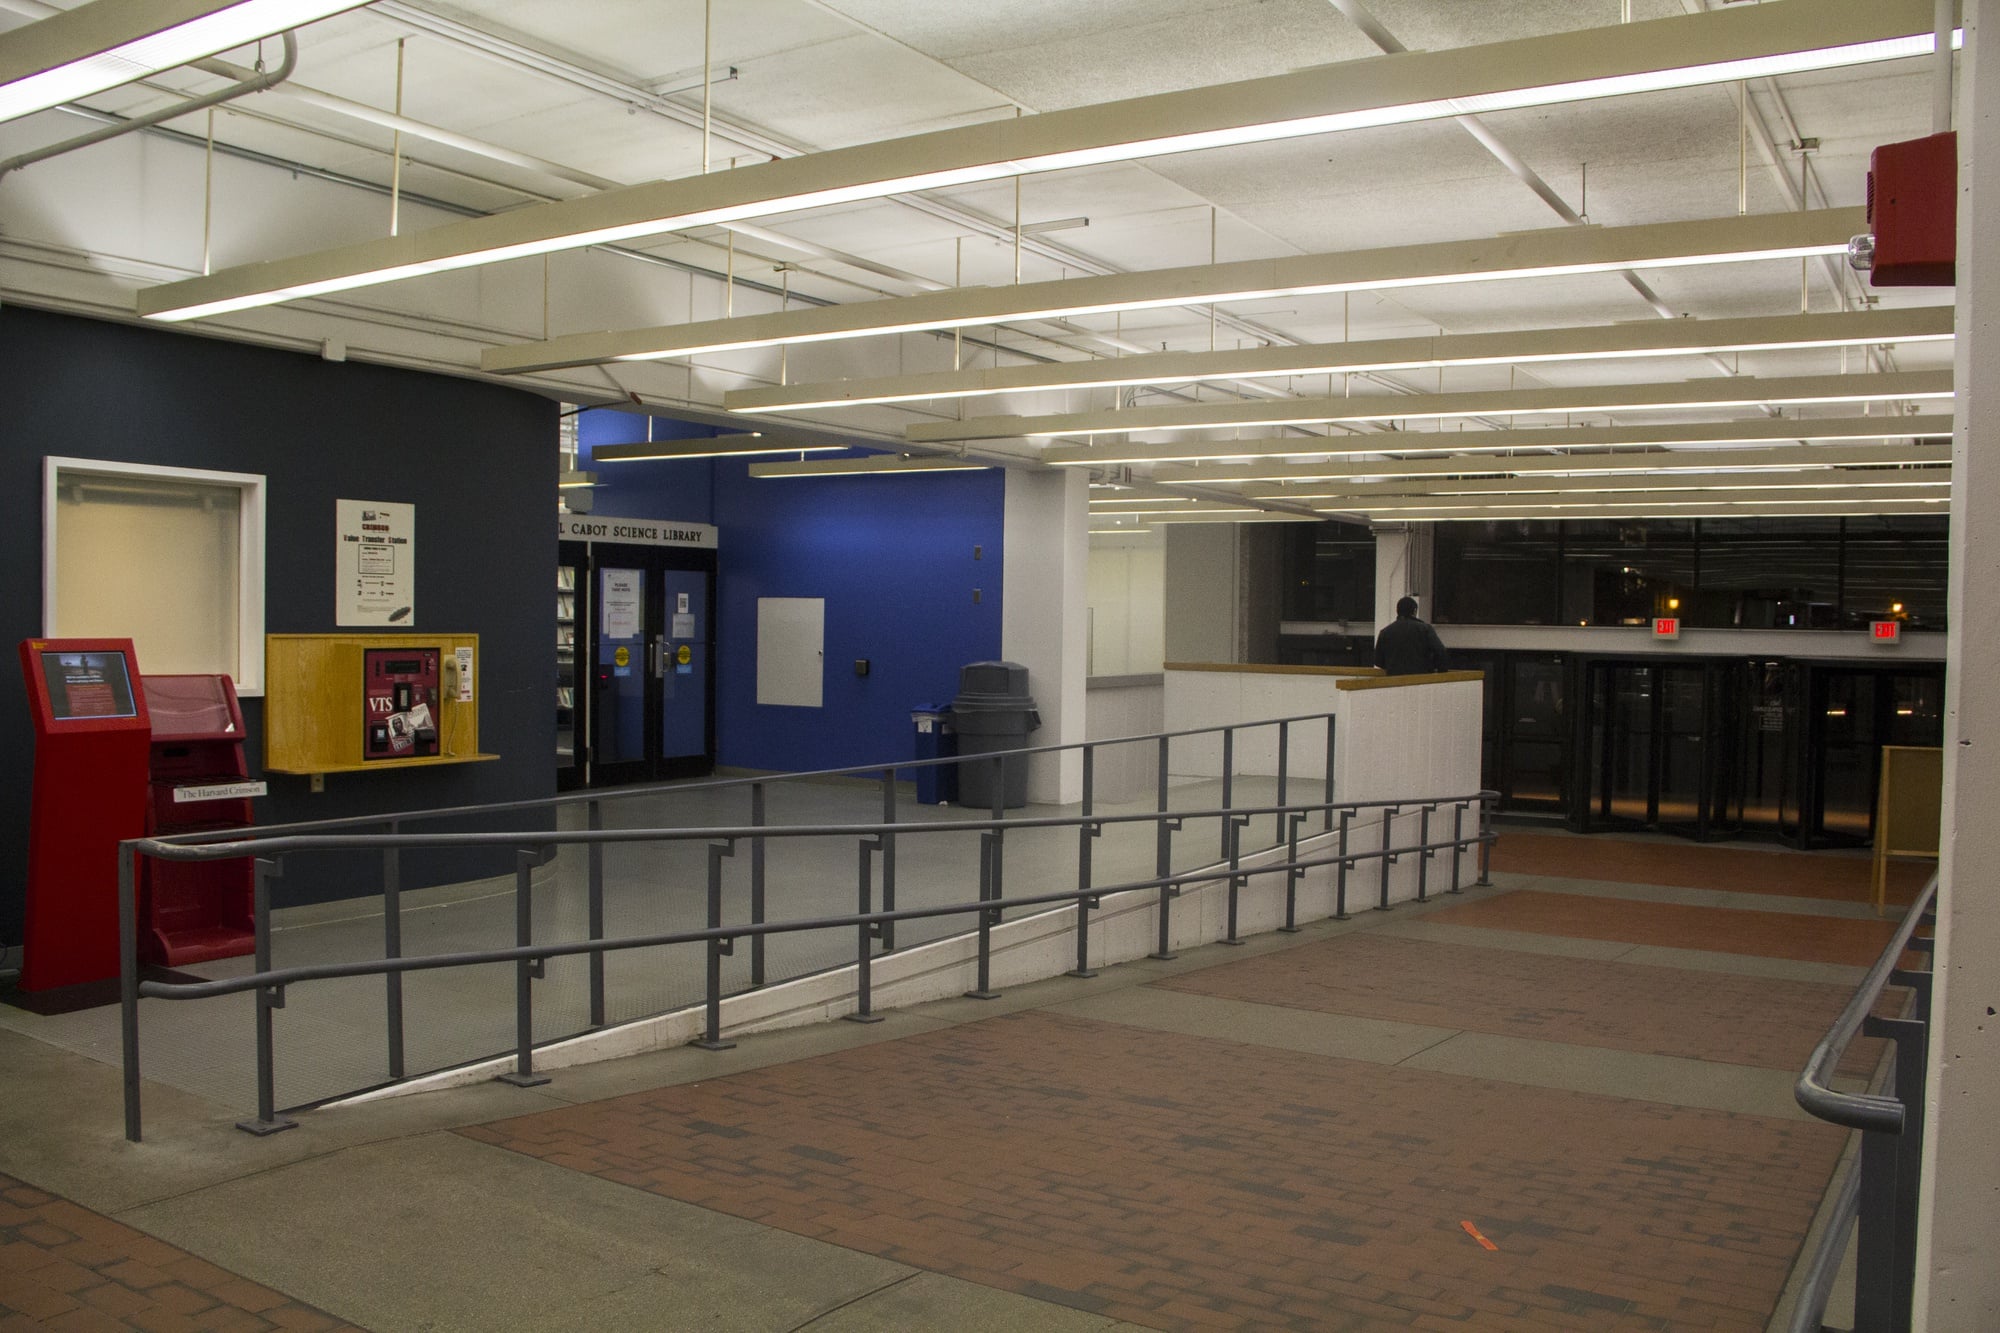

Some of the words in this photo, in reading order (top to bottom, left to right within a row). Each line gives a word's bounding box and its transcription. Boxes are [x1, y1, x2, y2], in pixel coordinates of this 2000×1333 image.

[571, 523, 607, 537] CABOT
[613, 526, 658, 539] SCIENCE
[663, 529, 702, 542] LIBRARY
[1657, 619, 1676, 634] EXIT
[1875, 622, 1896, 638] EXIT
[369, 697, 393, 712] VTS
[183, 790, 197, 799] The
[198, 787, 229, 797] Harvard
[229, 786, 260, 795] Crimson
